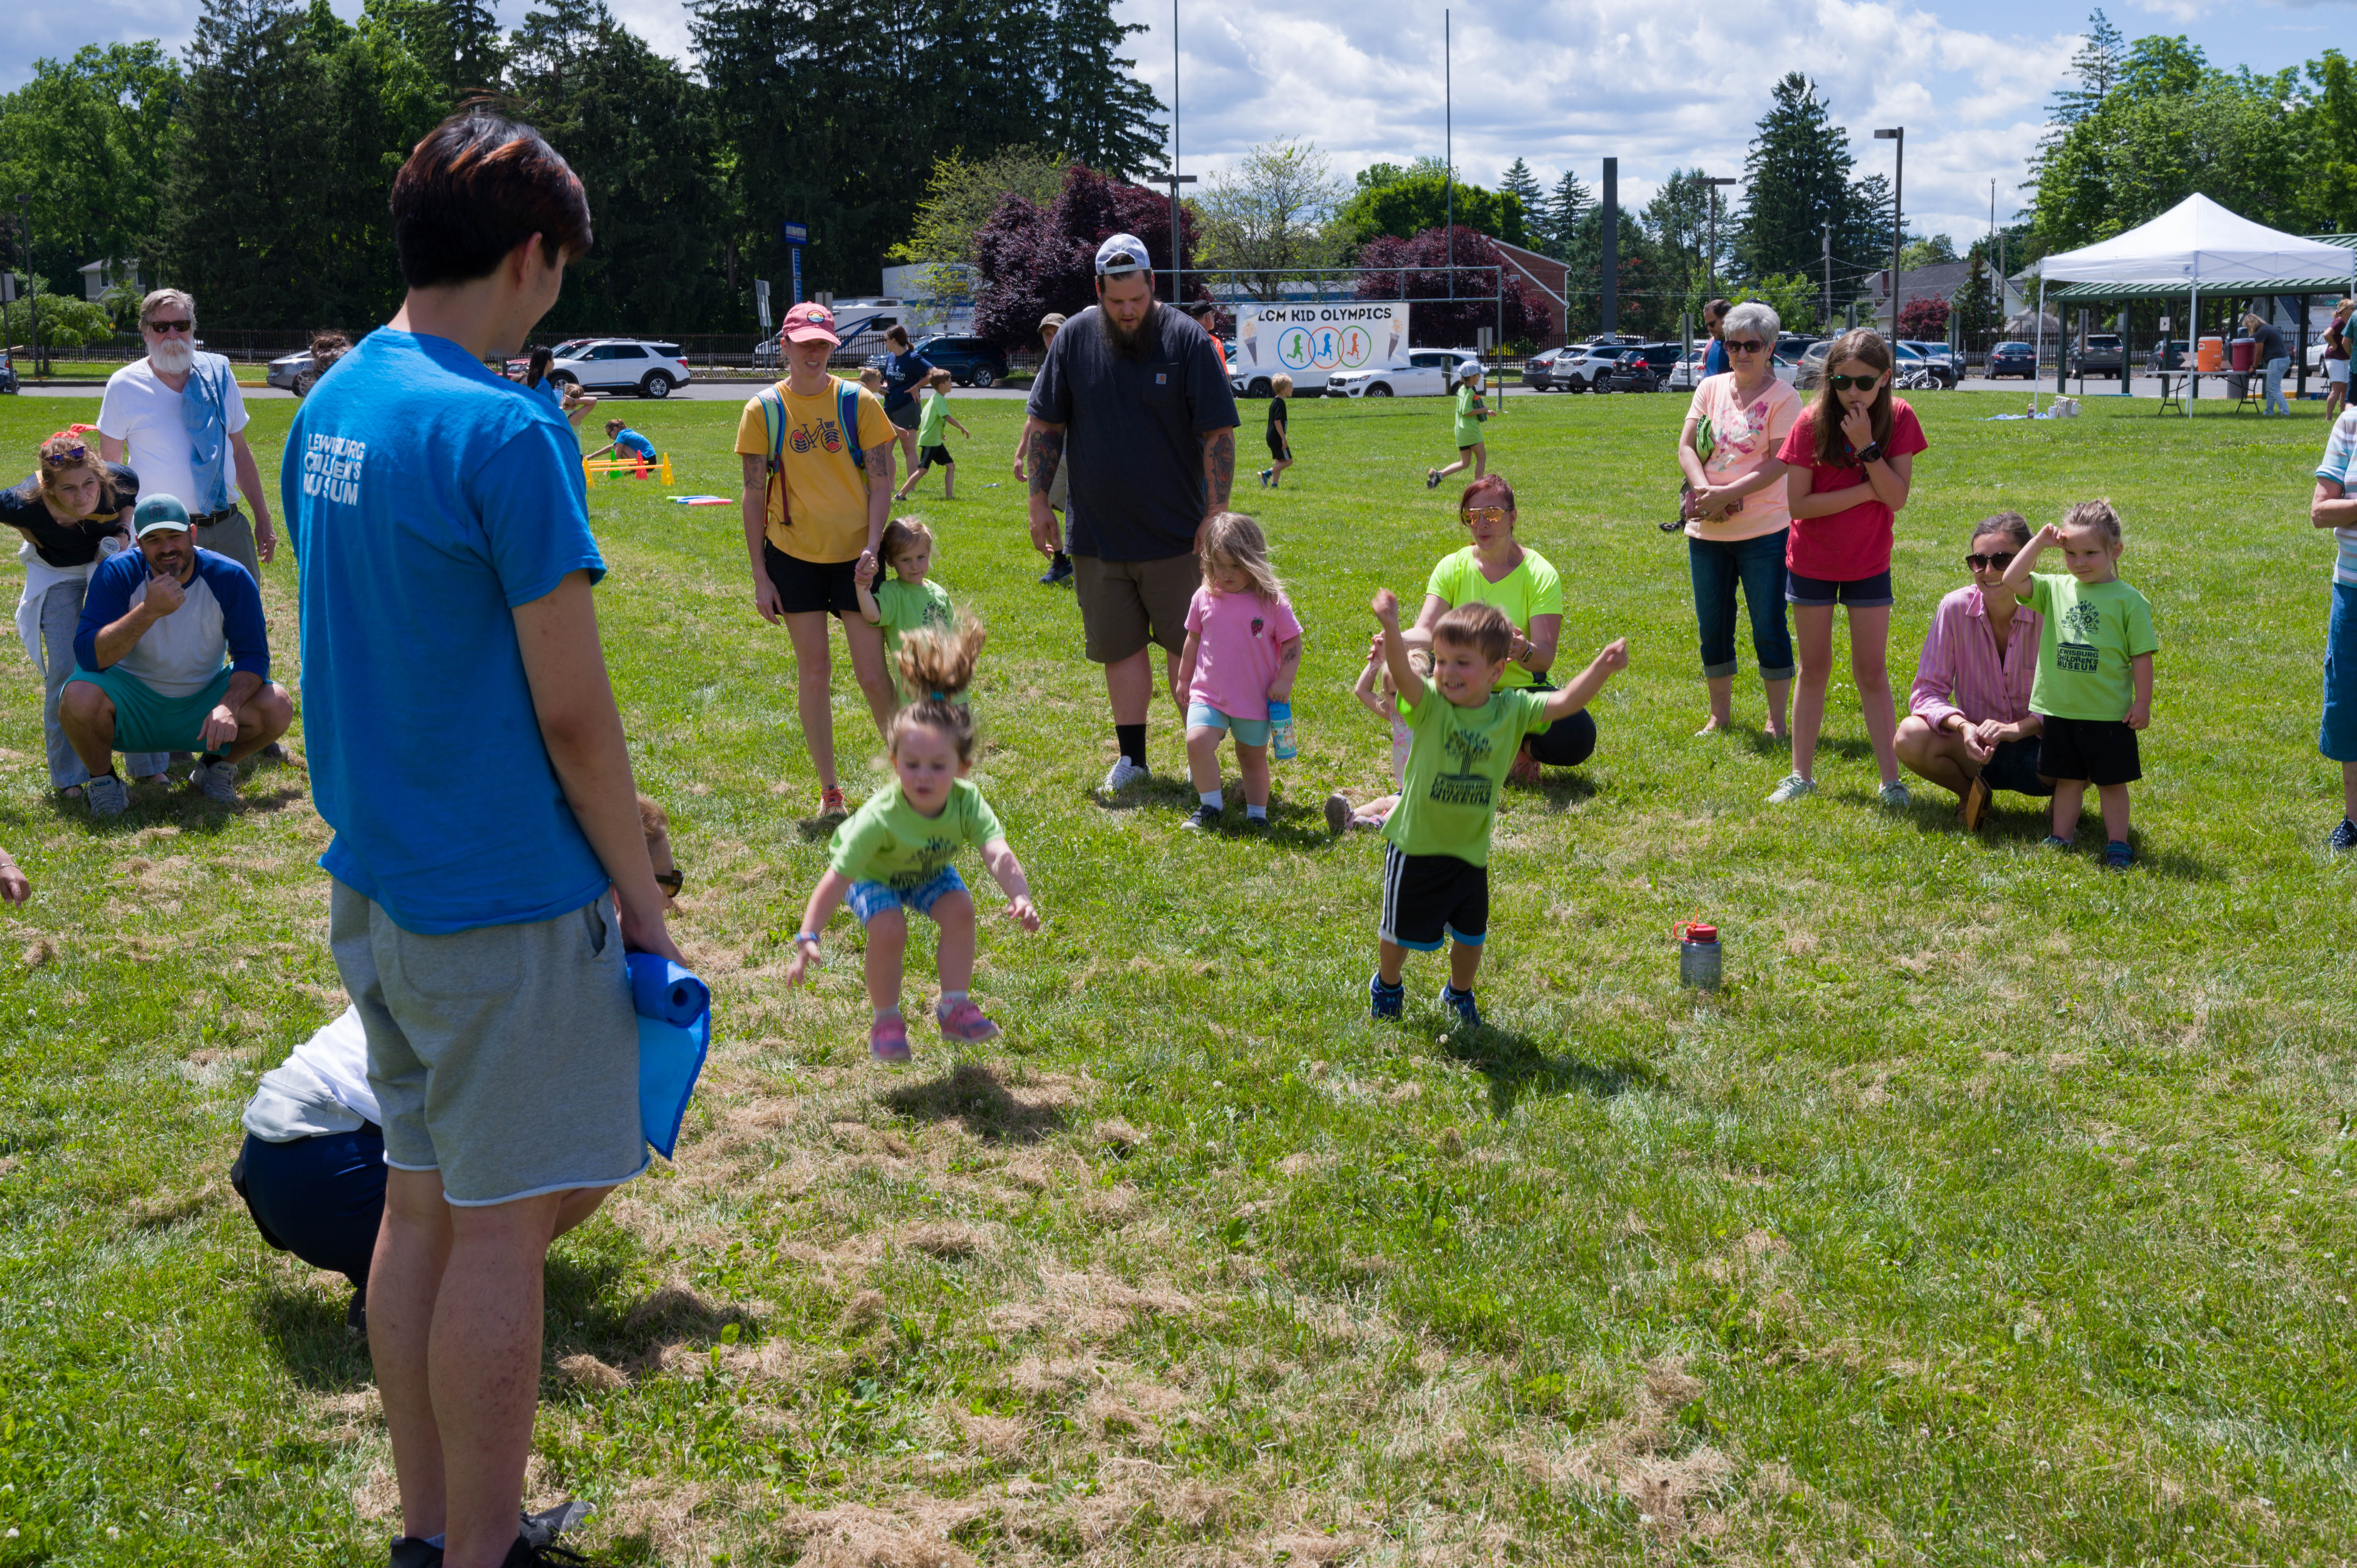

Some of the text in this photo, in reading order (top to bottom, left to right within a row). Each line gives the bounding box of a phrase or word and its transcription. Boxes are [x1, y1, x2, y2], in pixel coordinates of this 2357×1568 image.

[1258, 307, 1392, 322] LCM KID OLYMPICS
[307, 433, 366, 460] LEWIBURG
[303, 473, 359, 506] MUSUM
[2057, 648, 2099, 658] LEWISBURG
[2057, 654, 2098, 664] CHILDREN'S
[2057, 661, 2097, 671] MUSEUM
